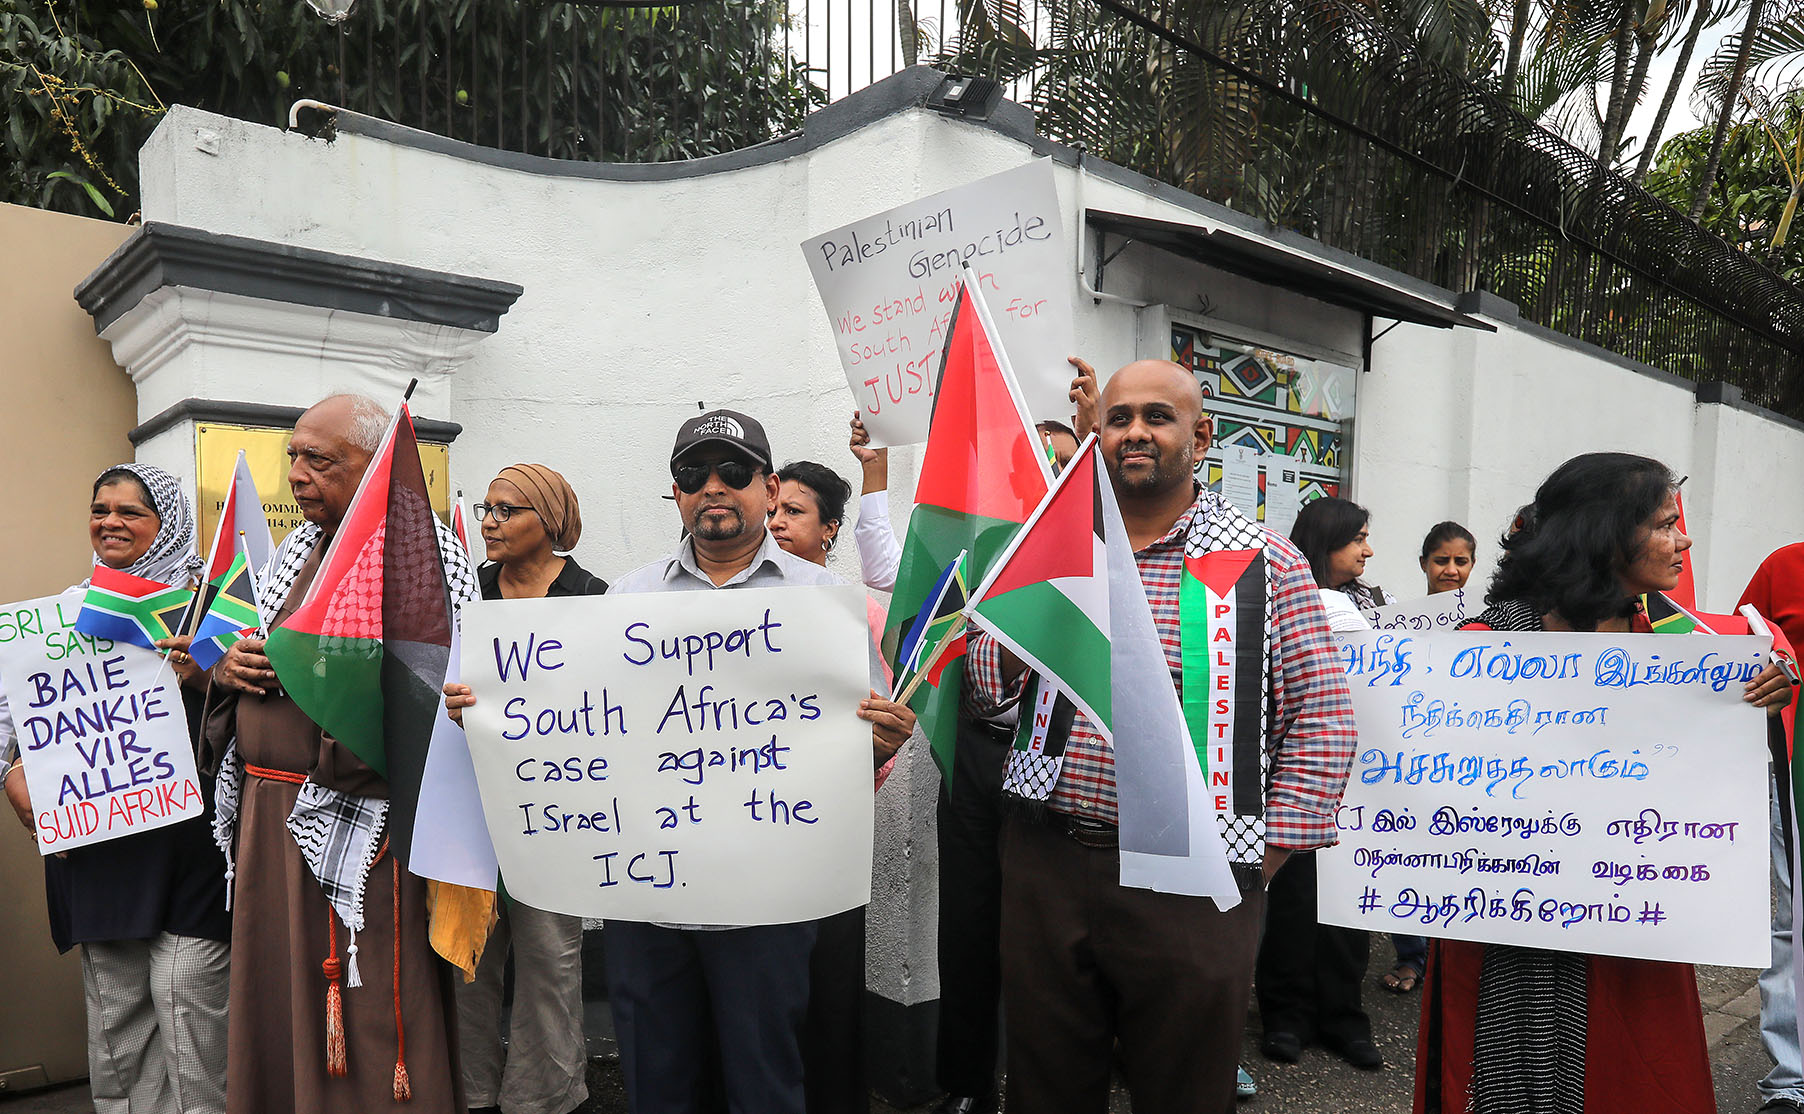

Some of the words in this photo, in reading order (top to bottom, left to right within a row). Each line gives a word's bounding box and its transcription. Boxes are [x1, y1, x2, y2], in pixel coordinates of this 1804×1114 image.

[820, 207, 953, 272] Palestinian
[908, 212, 1051, 280] Genocide
[838, 311, 867, 336] We
[939, 270, 1000, 303] wih
[850, 329, 911, 366] South
[1005, 297, 1047, 322] for
[693, 421, 727, 434] NORTH
[700, 427, 726, 435] FACE
[267, 518, 288, 529] 114,
[0, 608, 44, 642] SRI
[493, 632, 565, 683] We
[623, 608, 782, 676] Support
[28, 656, 130, 709] BAIE
[1450, 642, 1582, 684] எல்லா
[23, 687, 170, 751] DANKIE
[502, 687, 628, 741] South
[656, 684, 822, 734] Africa's
[1031, 681, 1049, 750] INE
[1212, 604, 1232, 811] PALESTINE
[76, 728, 152, 769] VIR
[516, 756, 609, 783] case
[657, 734, 791, 785] against
[57, 752, 176, 806] ALLES
[39, 803, 99, 844] SUID
[108, 779, 203, 831] AFRIKA
[655, 796, 703, 830] at
[744, 788, 820, 826] the
[1372, 807, 1417, 833] இல்
[1606, 808, 1739, 845] எதிரான
[593, 850, 688, 888] ICJ.
